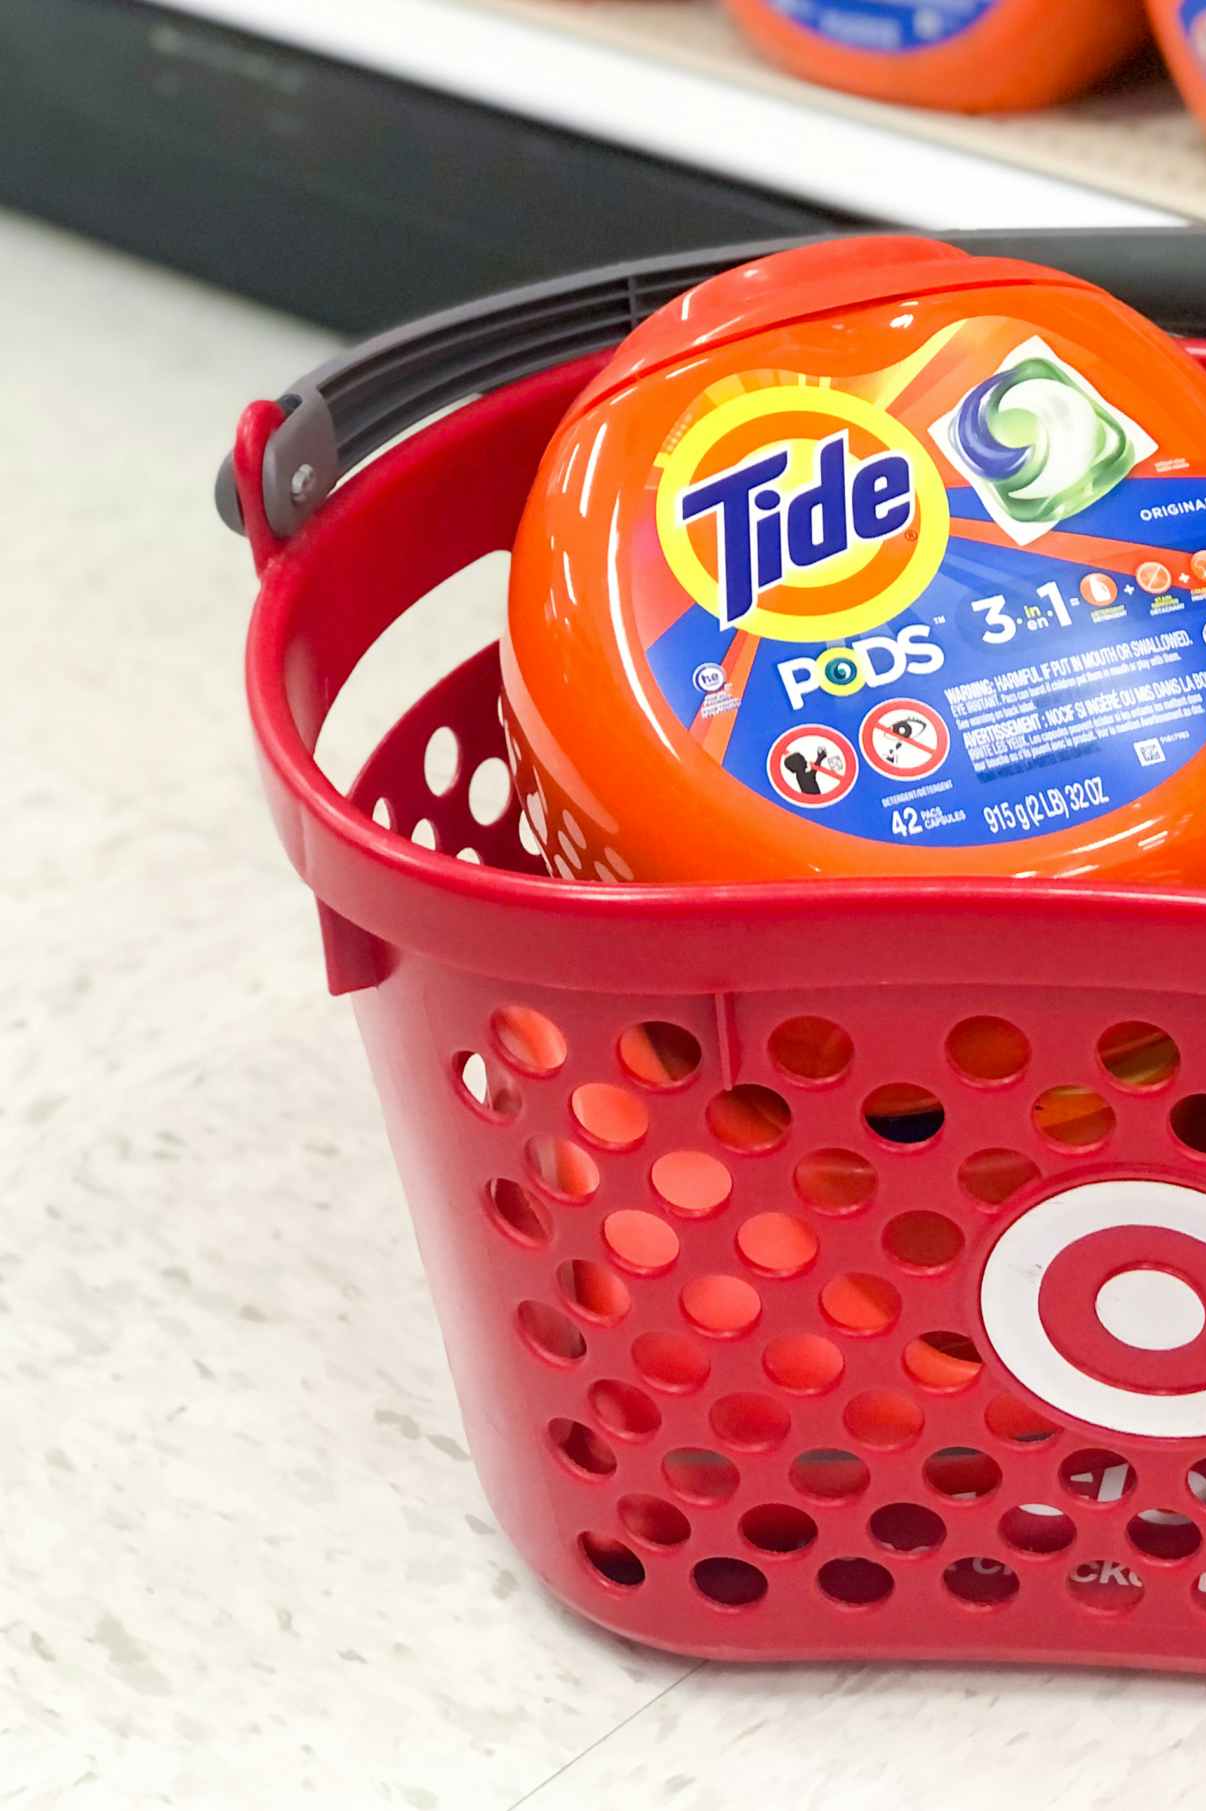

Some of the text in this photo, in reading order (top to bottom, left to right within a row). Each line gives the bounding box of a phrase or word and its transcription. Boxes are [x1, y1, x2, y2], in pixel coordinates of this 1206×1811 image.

[680, 434, 913, 626] Tide
[701, 673, 719, 684] he
[777, 624, 945, 711] PODS
[944, 678, 994, 704] WARNING:
[994, 666, 1042, 692] HARMFUL
[1041, 662, 1051, 679] IF
[1050, 657, 1071, 677] PUT
[1081, 646, 1118, 669] MOUTH
[1116, 642, 1132, 660] OR
[1131, 630, 1193, 657] SWALLOWED.
[962, 713, 1041, 748] AVERTISSEMENT
[1045, 703, 1074, 727] NOCIF
[1074, 701, 1085, 720] SI
[1120, 687, 1136, 707] OU
[1135, 684, 1155, 702] MIS
[1152, 678, 1181, 699] DANS
[1179, 675, 1195, 692] LA
[891, 806, 942, 837] 42 PACS
[924, 809, 966, 830] CAPSULES
[983, 775, 1110, 834] 915 g (2 LB) 32 OZ
